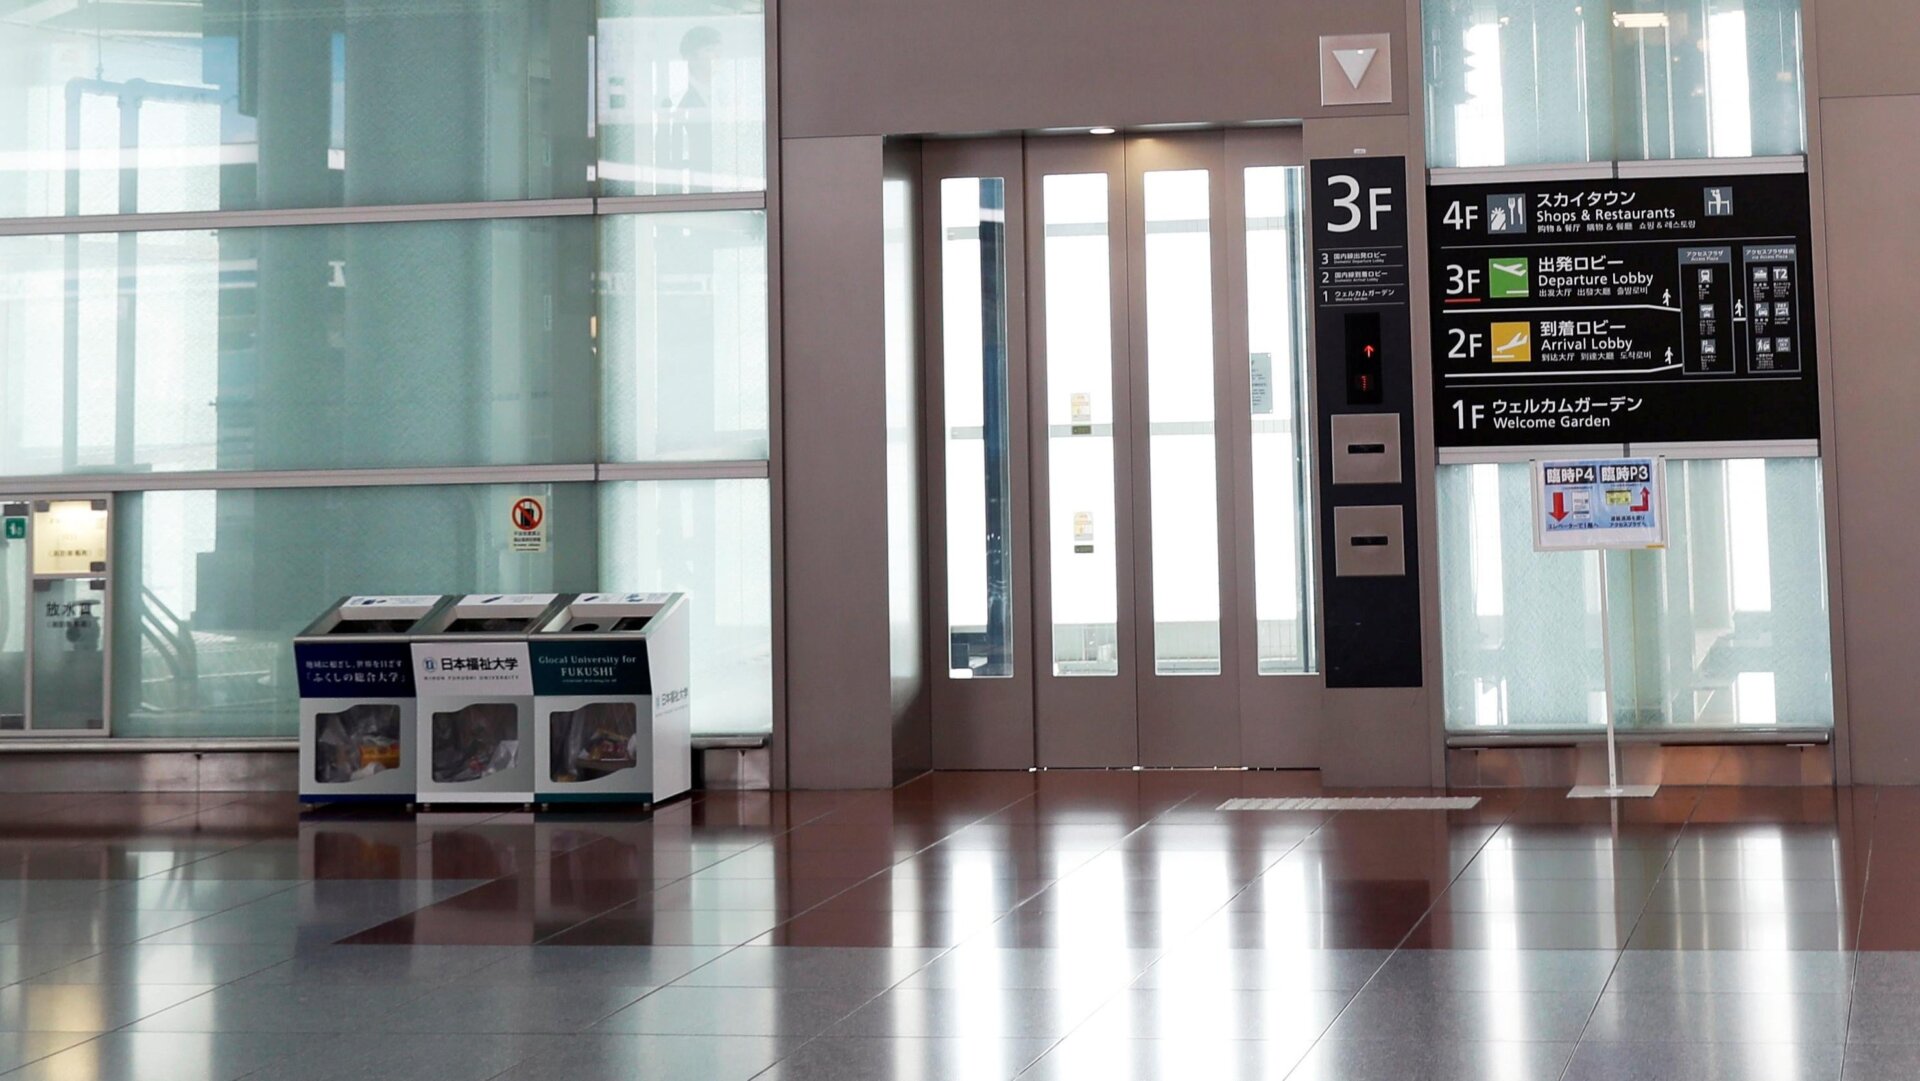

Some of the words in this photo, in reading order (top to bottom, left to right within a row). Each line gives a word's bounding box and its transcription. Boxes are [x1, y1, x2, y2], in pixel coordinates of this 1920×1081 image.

[1327, 174, 1392, 233] 3F
[1537, 191, 1636, 208] スカイタウン
[1443, 200, 1479, 231] 4F
[1537, 210, 1577, 224] Shops
[1581, 209, 1591, 221] &
[1595, 207, 1676, 220] Restaurants
[1321, 252, 1329, 265] 3
[1538, 255, 1624, 273] 出発ロビー
[1321, 271, 1330, 284] 2
[1446, 264, 1481, 295] 3F
[1538, 274, 1608, 288] Departure
[1612, 271, 1654, 287] Lobby
[1773, 268, 1788, 279] T2
[1322, 290, 1328, 303] 1
[1540, 320, 1626, 337] 到着ロビー
[1448, 328, 1482, 358] 2F
[1541, 337, 1586, 351] Arrival
[1591, 337, 1633, 352] Lobby
[1492, 396, 1643, 414] ウェルカムガーデン
[1452, 399, 1485, 430] 1F
[1493, 416, 1556, 429] Welcome
[1560, 415, 1611, 428] Garden
[1546, 467, 1594, 484] 臨時P4
[1601, 465, 1649, 482] 臨時P3
[441, 657, 518, 671] 日本福祉大学
[538, 655, 568, 664] Glocal
[570, 655, 619, 666] University
[622, 654, 636, 663] for
[560, 667, 614, 677] FUKUSHI
